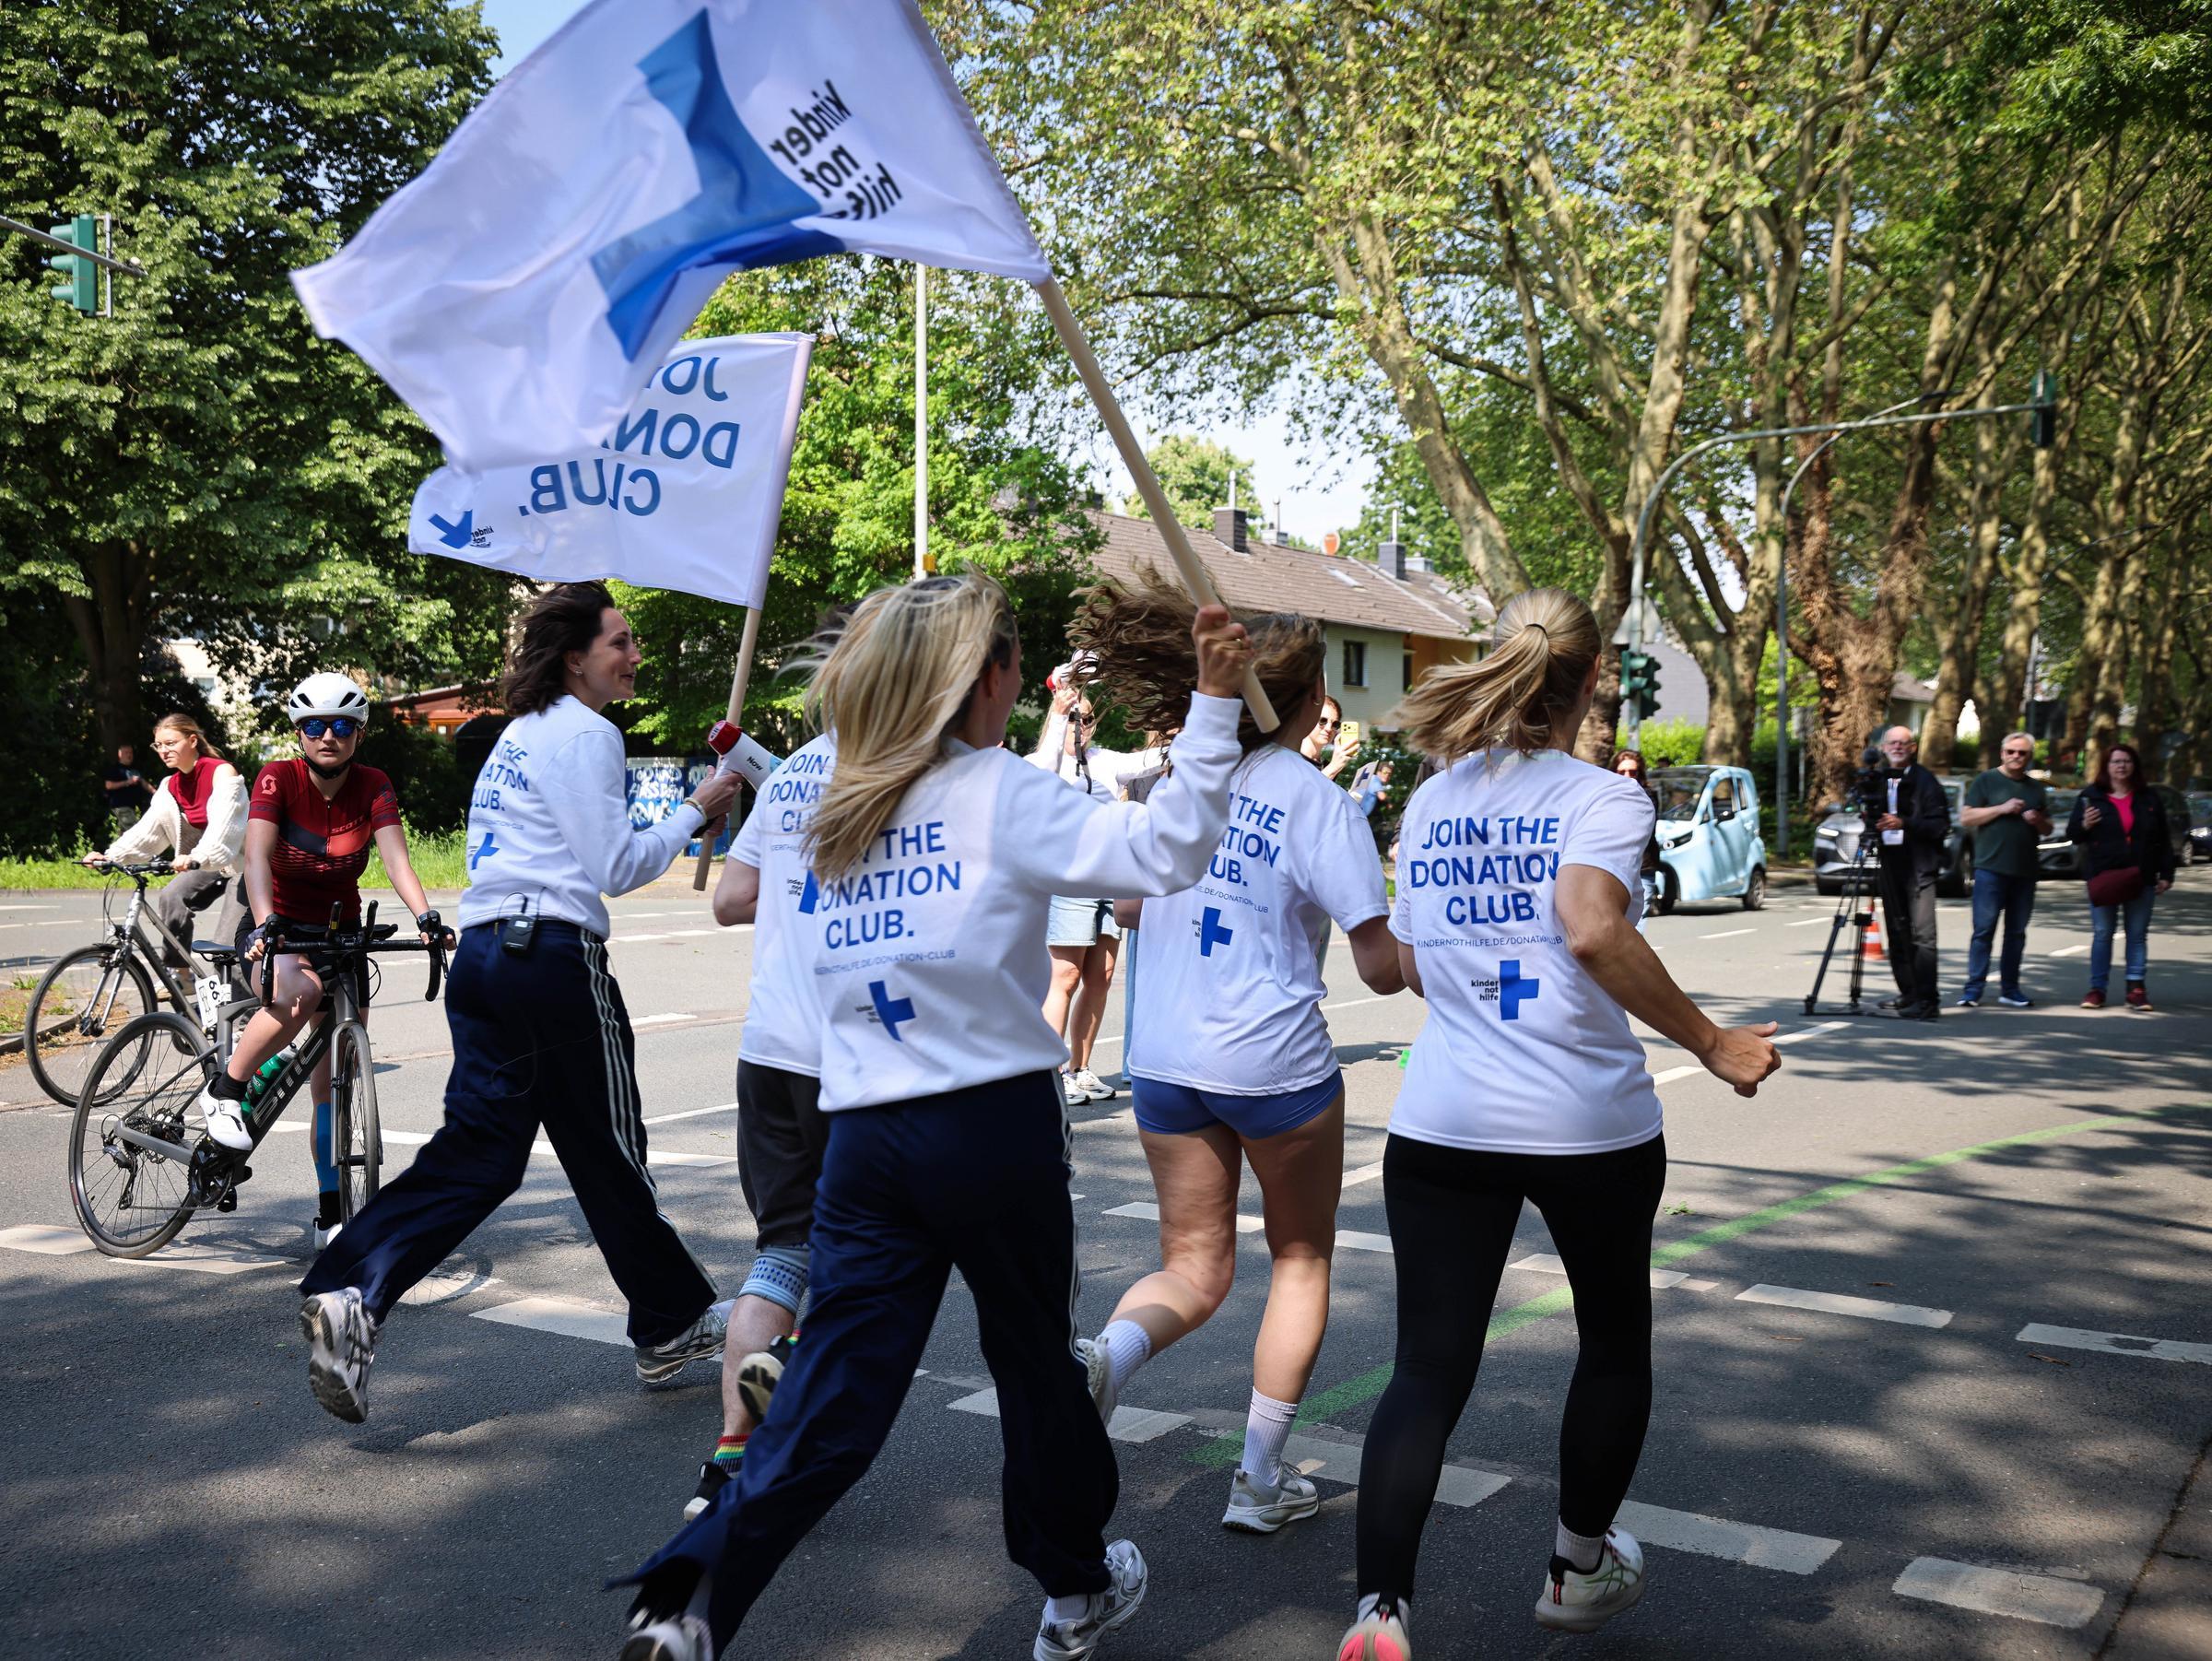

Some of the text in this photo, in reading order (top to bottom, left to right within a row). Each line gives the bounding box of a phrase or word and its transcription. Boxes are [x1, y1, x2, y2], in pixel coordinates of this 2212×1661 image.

[782, 753, 831, 775] JOIN
[769, 780, 821, 805] DONA
[331, 815, 366, 834] SCOTT
[1237, 795, 1286, 834] THE
[878, 820, 946, 860] THE
[1421, 816, 1560, 850] JOIN THE
[820, 861, 961, 913] ONATION
[1204, 854, 1249, 887] UB.
[1445, 891, 1541, 925] CLUB.
[825, 909, 915, 949] CLUB.
[1470, 979, 1500, 988] kinder
[1479, 994, 1500, 1002] hilfe
